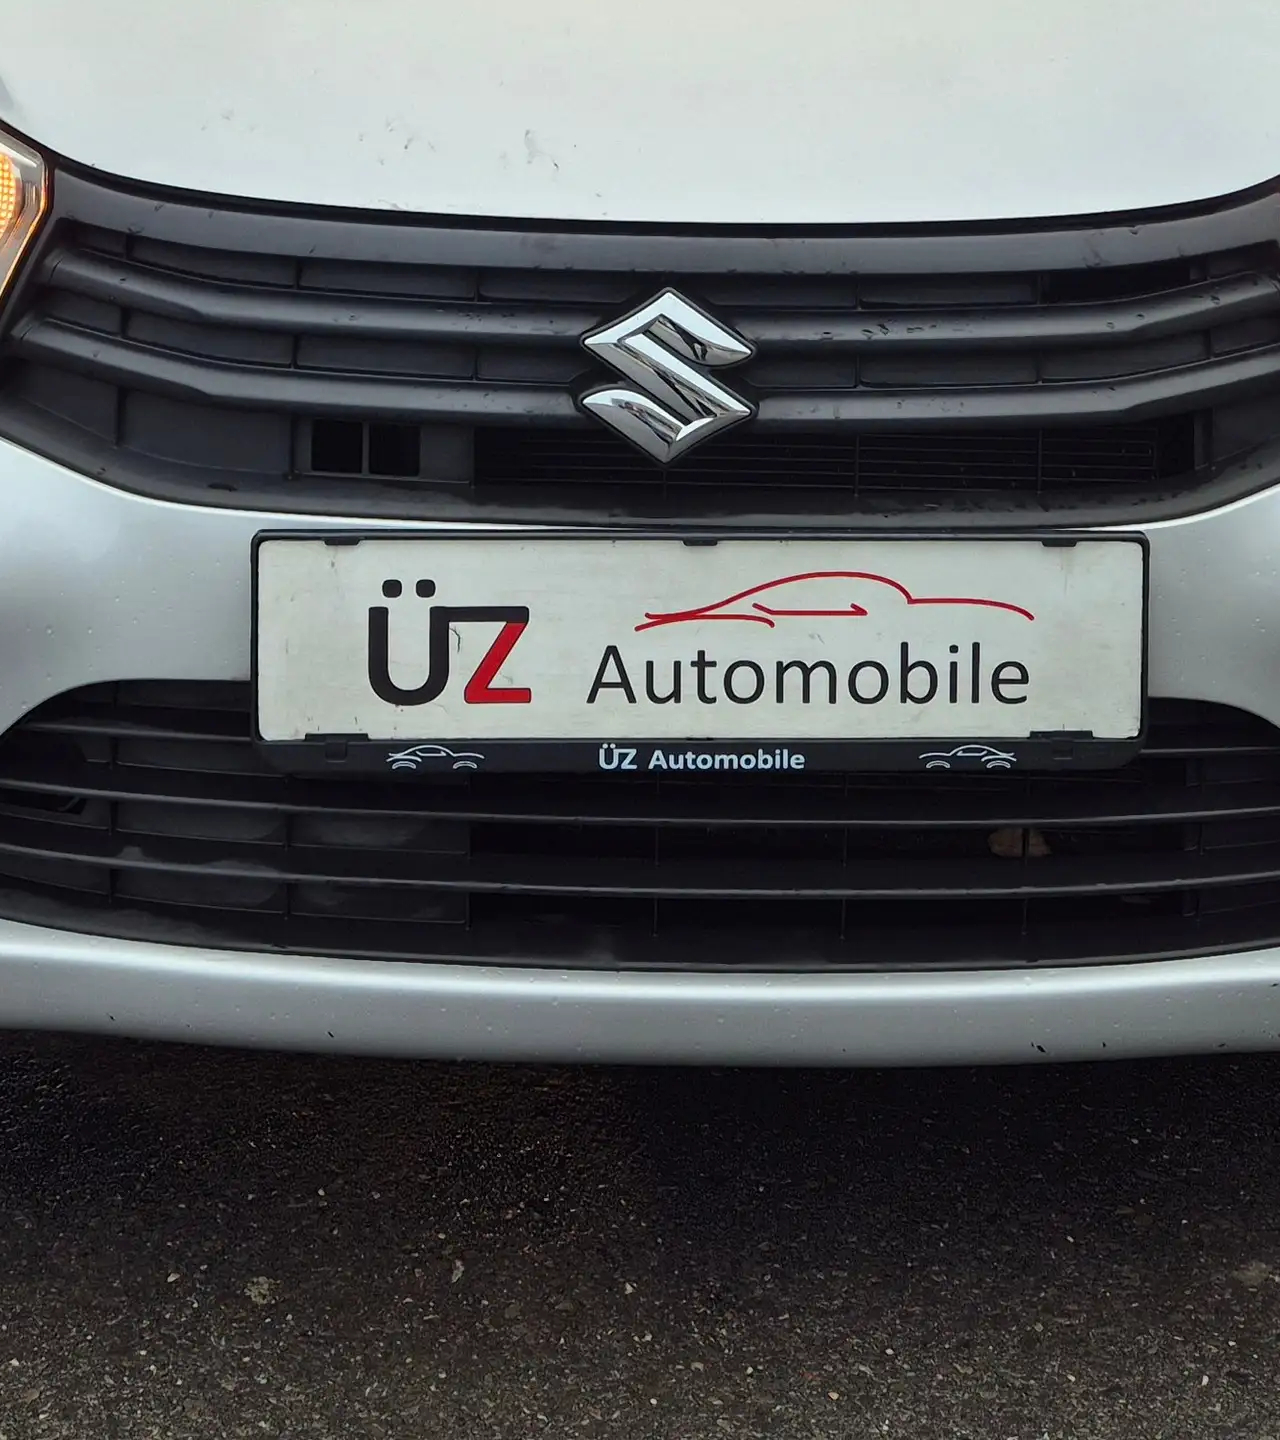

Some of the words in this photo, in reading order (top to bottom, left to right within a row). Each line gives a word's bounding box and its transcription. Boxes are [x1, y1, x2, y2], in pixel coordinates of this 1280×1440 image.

[366, 578, 532, 706] ÜZ
[586, 640, 1030, 706] Automobile
[598, 743, 638, 771] ÜZ
[648, 747, 806, 772] Automobile
